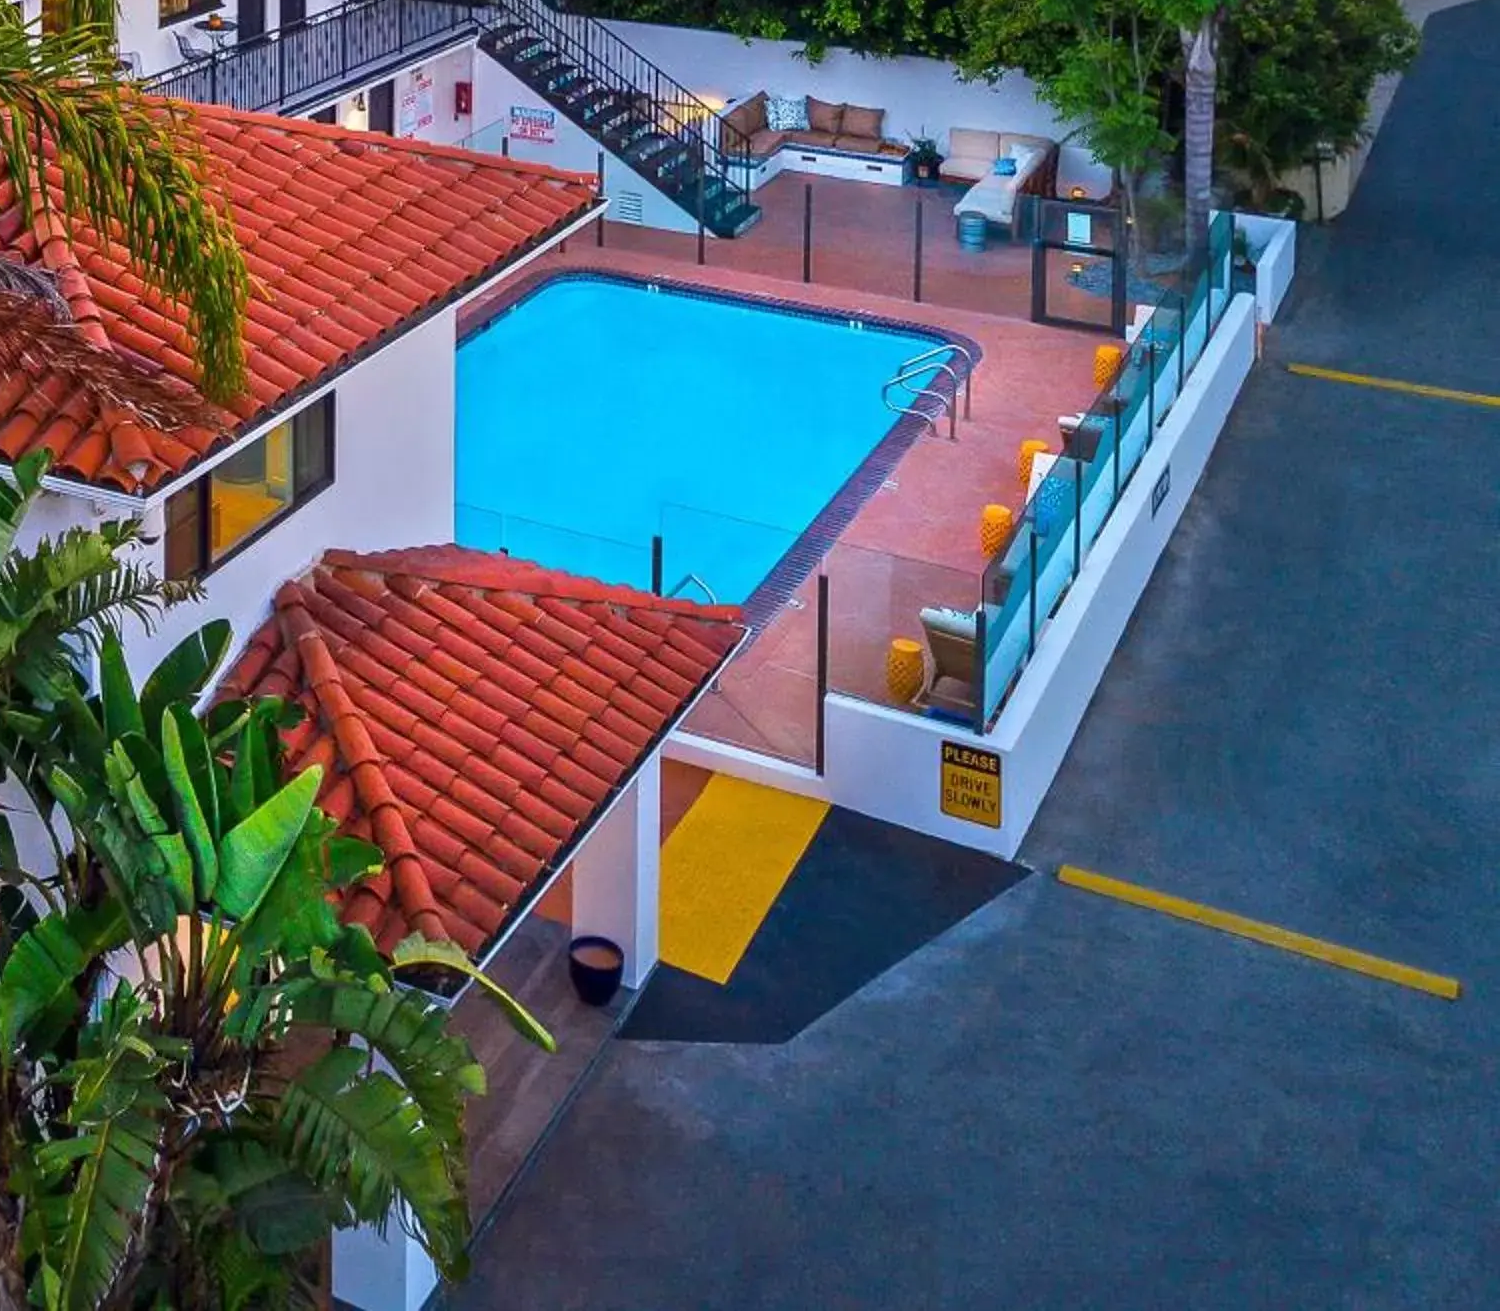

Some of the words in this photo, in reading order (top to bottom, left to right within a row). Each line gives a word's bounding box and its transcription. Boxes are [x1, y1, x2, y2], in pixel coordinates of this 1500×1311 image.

[945, 746, 997, 772] PLEASE
[952, 774, 991, 796] DRIVE
[945, 789, 997, 813] SLOWLY
